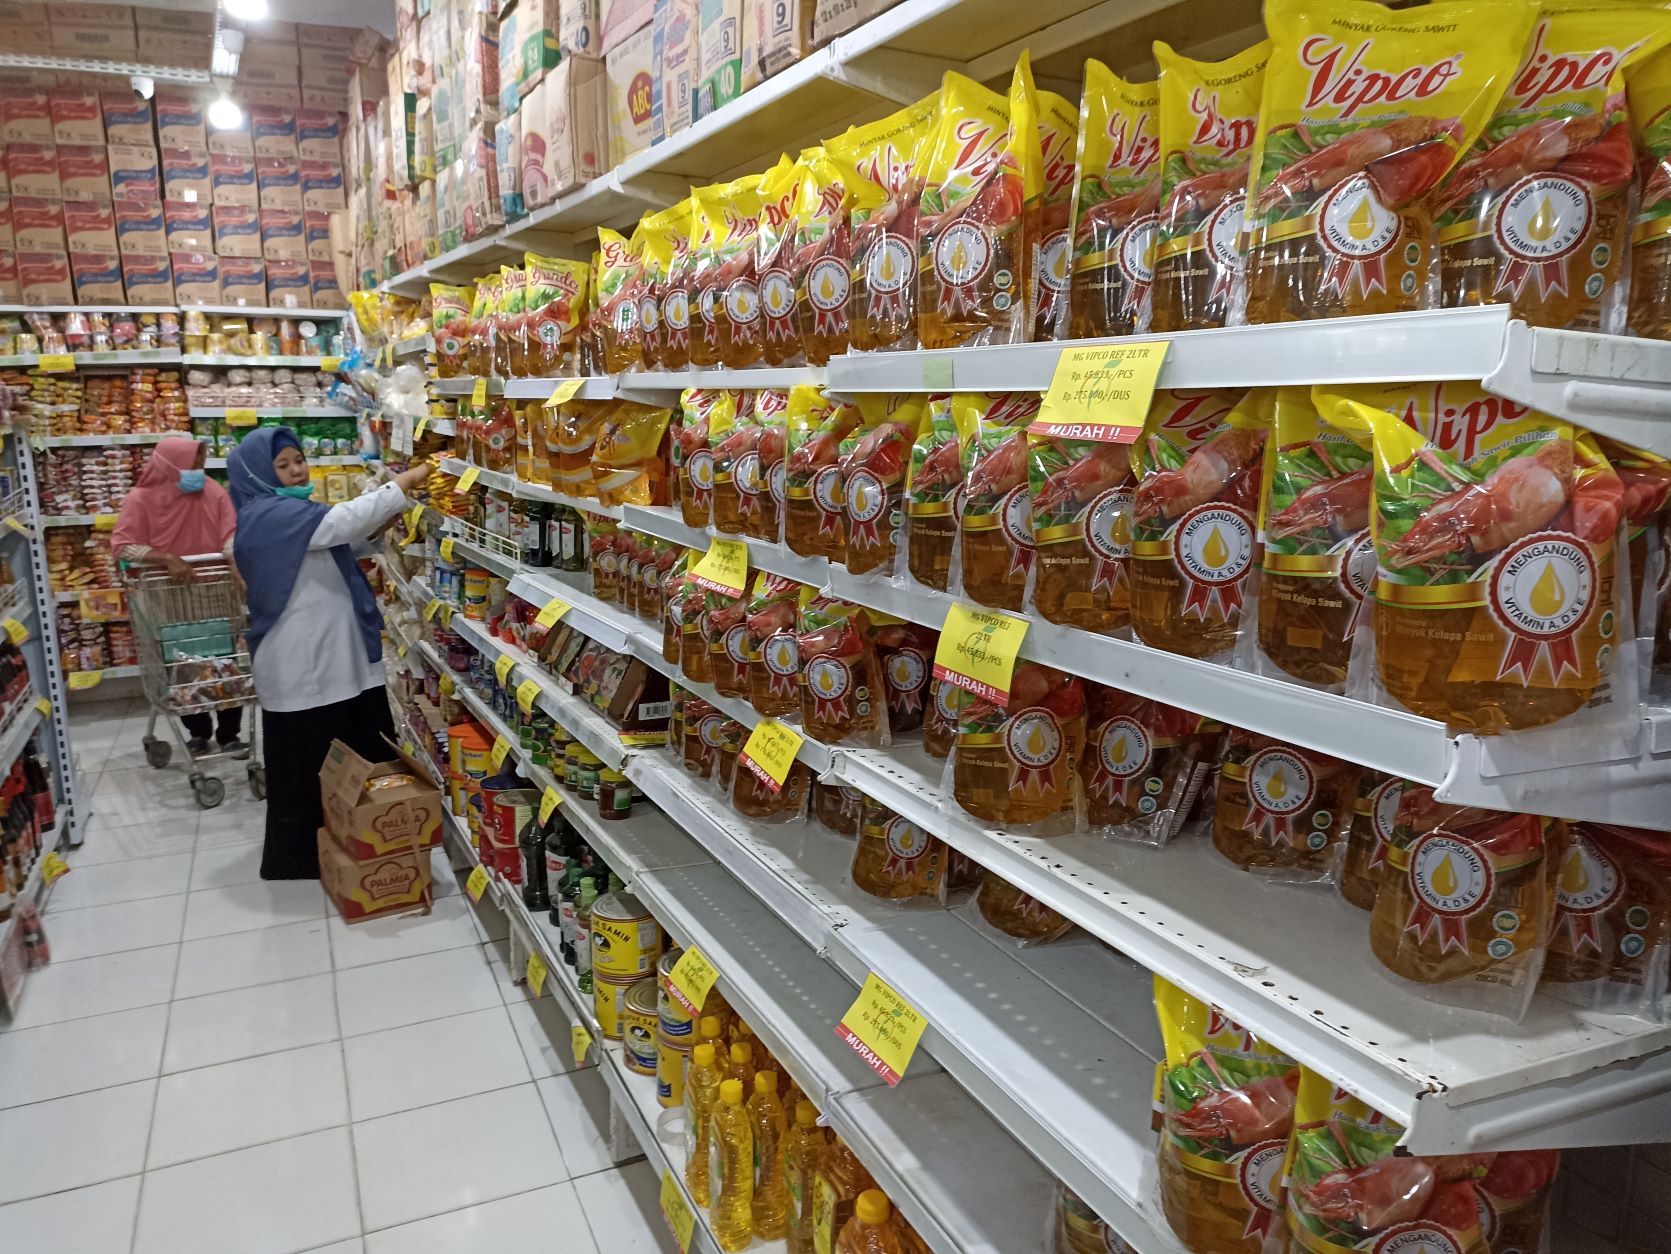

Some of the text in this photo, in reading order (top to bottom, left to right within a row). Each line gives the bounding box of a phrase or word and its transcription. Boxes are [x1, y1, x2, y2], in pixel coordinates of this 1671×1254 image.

[776, 2, 786, 26] 9
[1302, 37, 1458, 119] Vipco
[632, 85, 652, 119] ABC
[1509, 180, 1583, 209] MENGANDUNG
[1504, 225, 1538, 254] VITAMIN
[1072, 348, 1150, 361] MG VIPCO REF 2LTR
[1047, 424, 1121, 440] MURAH !!
[1185, 512, 1248, 537] MENGANDUNG
[1093, 532, 1122, 555] VITAMIN
[1184, 552, 1215, 579] VITAMIN
[1228, 566, 1236, 575] D
[1236, 561, 1244, 570] &
[1241, 554, 1249, 562] E
[1507, 544, 1587, 577] MENGANDUNG
[696, 577, 726, 593] MURAH
[1318, 597, 1343, 609] Sawit
[1504, 597, 1545, 630] VITAMIN
[1562, 614, 1571, 625] D
[1571, 607, 1580, 616] &
[1578, 598, 1585, 606] E
[1427, 628, 1463, 642] Kelapa
[1464, 631, 1494, 642] Sawit
[944, 669, 986, 696] MURAH
[745, 757, 770, 783] MURAH
[1258, 757, 1306, 781] MENGANDUNG
[1421, 838, 1480, 874] MENGANDUNG
[371, 872, 411, 888] PALMIA
[1416, 871, 1440, 907] VITAMIN
[1452, 898, 1462, 908] D
[1468, 889, 1478, 900] E
[1584, 894, 1594, 905] D
[1601, 885, 1610, 895] E
[601, 923, 632, 944] SAMIN
[845, 1032, 882, 1068] MURAH
